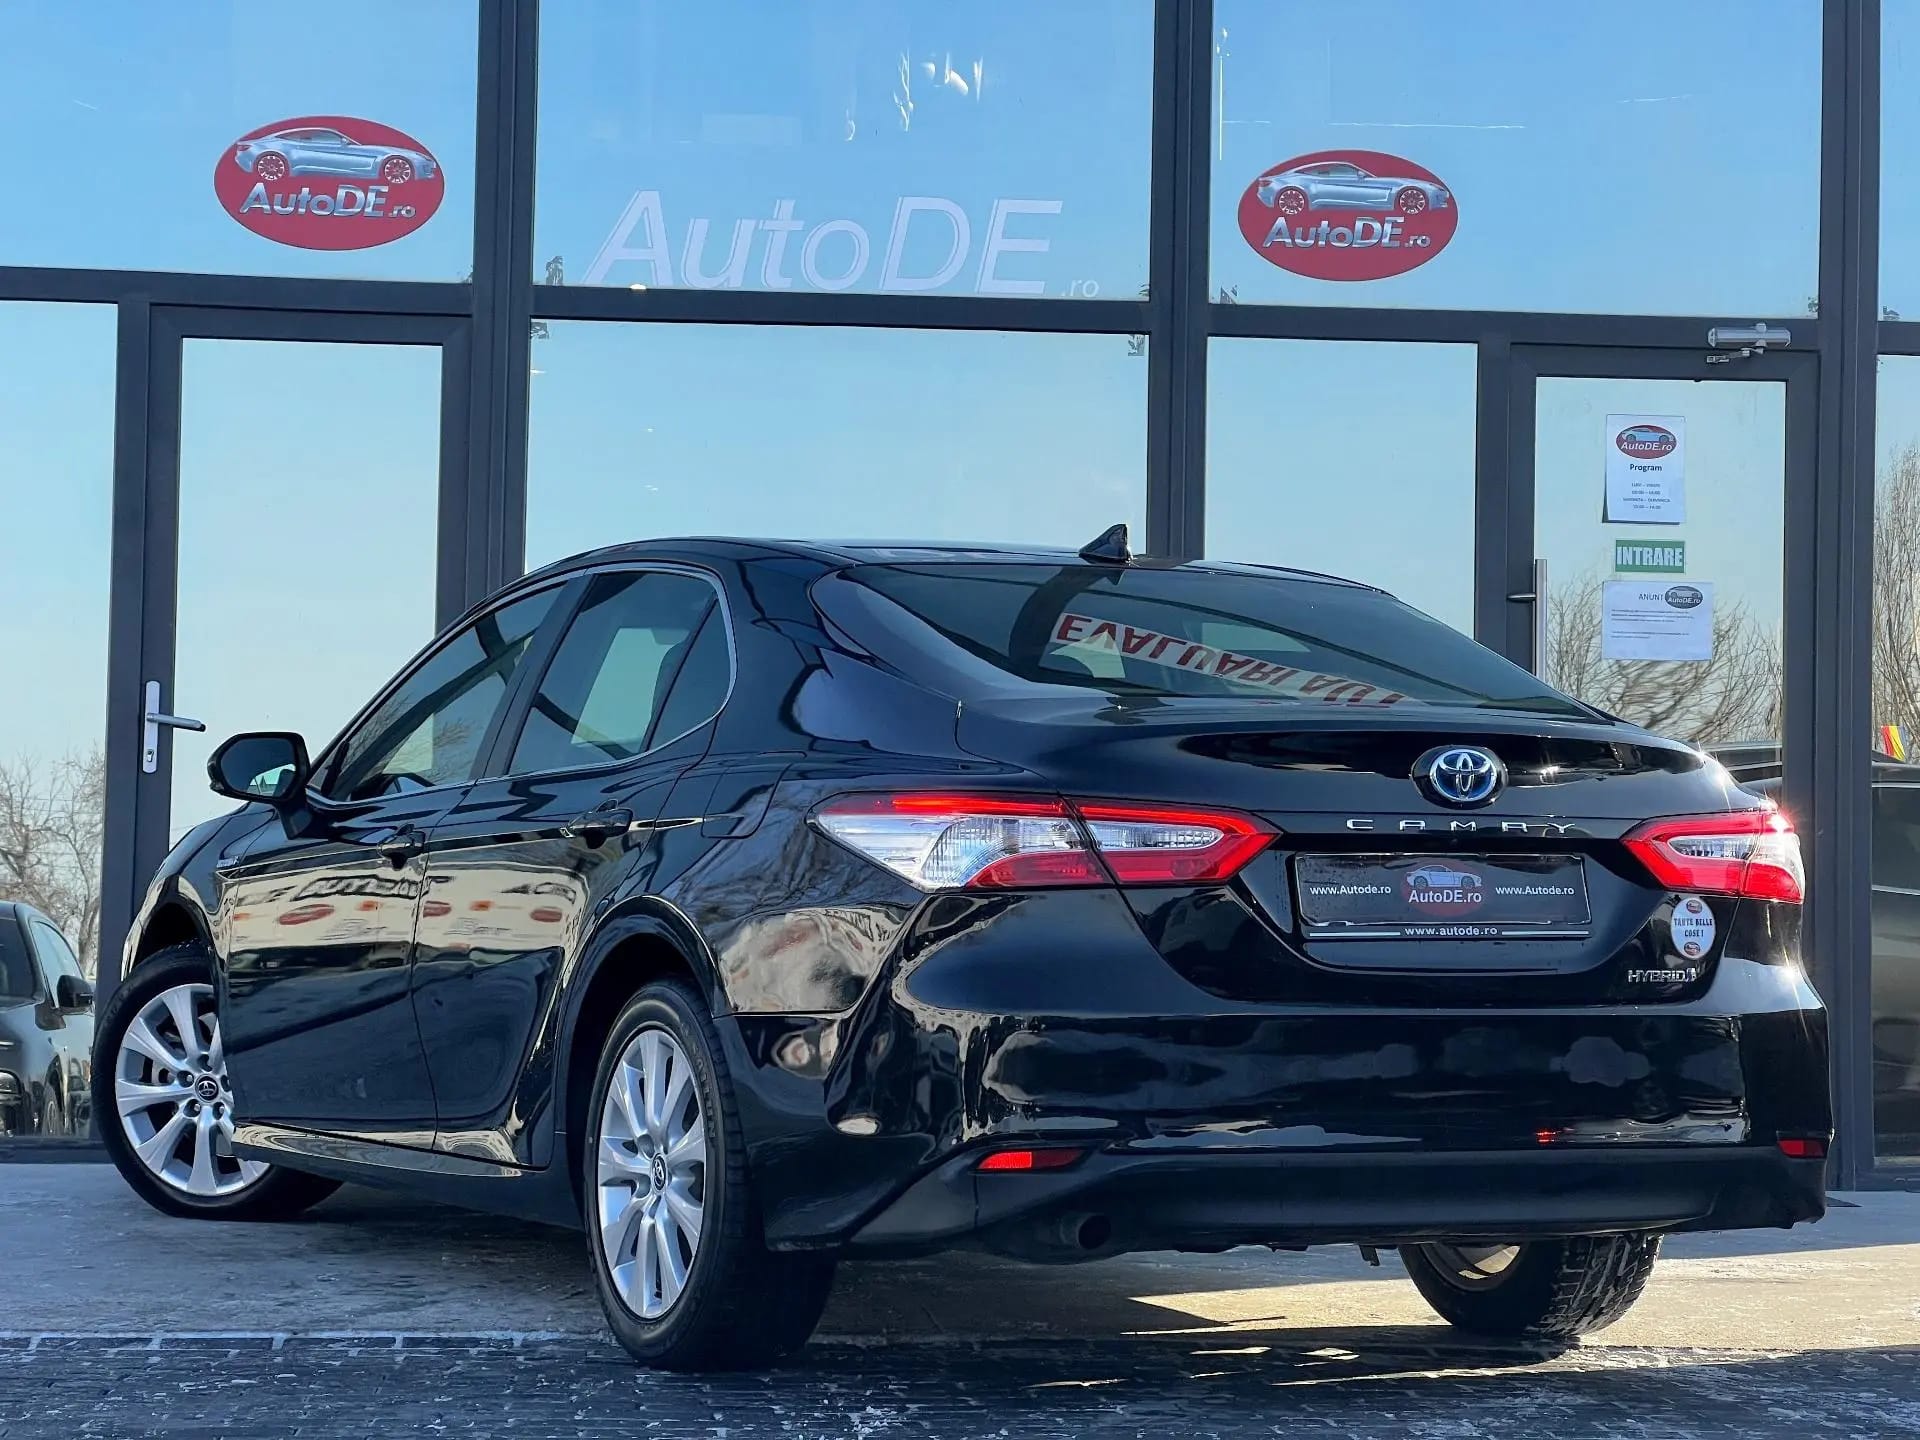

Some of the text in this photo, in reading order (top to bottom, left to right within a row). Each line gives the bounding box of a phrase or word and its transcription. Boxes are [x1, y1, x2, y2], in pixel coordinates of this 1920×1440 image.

[1620, 441, 1673, 451] AutoDE.ro
[1629, 463, 1663, 472] Program
[1616, 546, 1683, 566] INTRARE
[1346, 819, 1575, 833] CAMRY
[1309, 884, 1391, 895] www.Autode.ro
[1495, 885, 1575, 895] www.Autode.ro
[1408, 889, 1482, 903] AutoDE.ro
[1404, 926, 1498, 936] www.autode.ro
[1627, 969, 1686, 982] HYBRID
